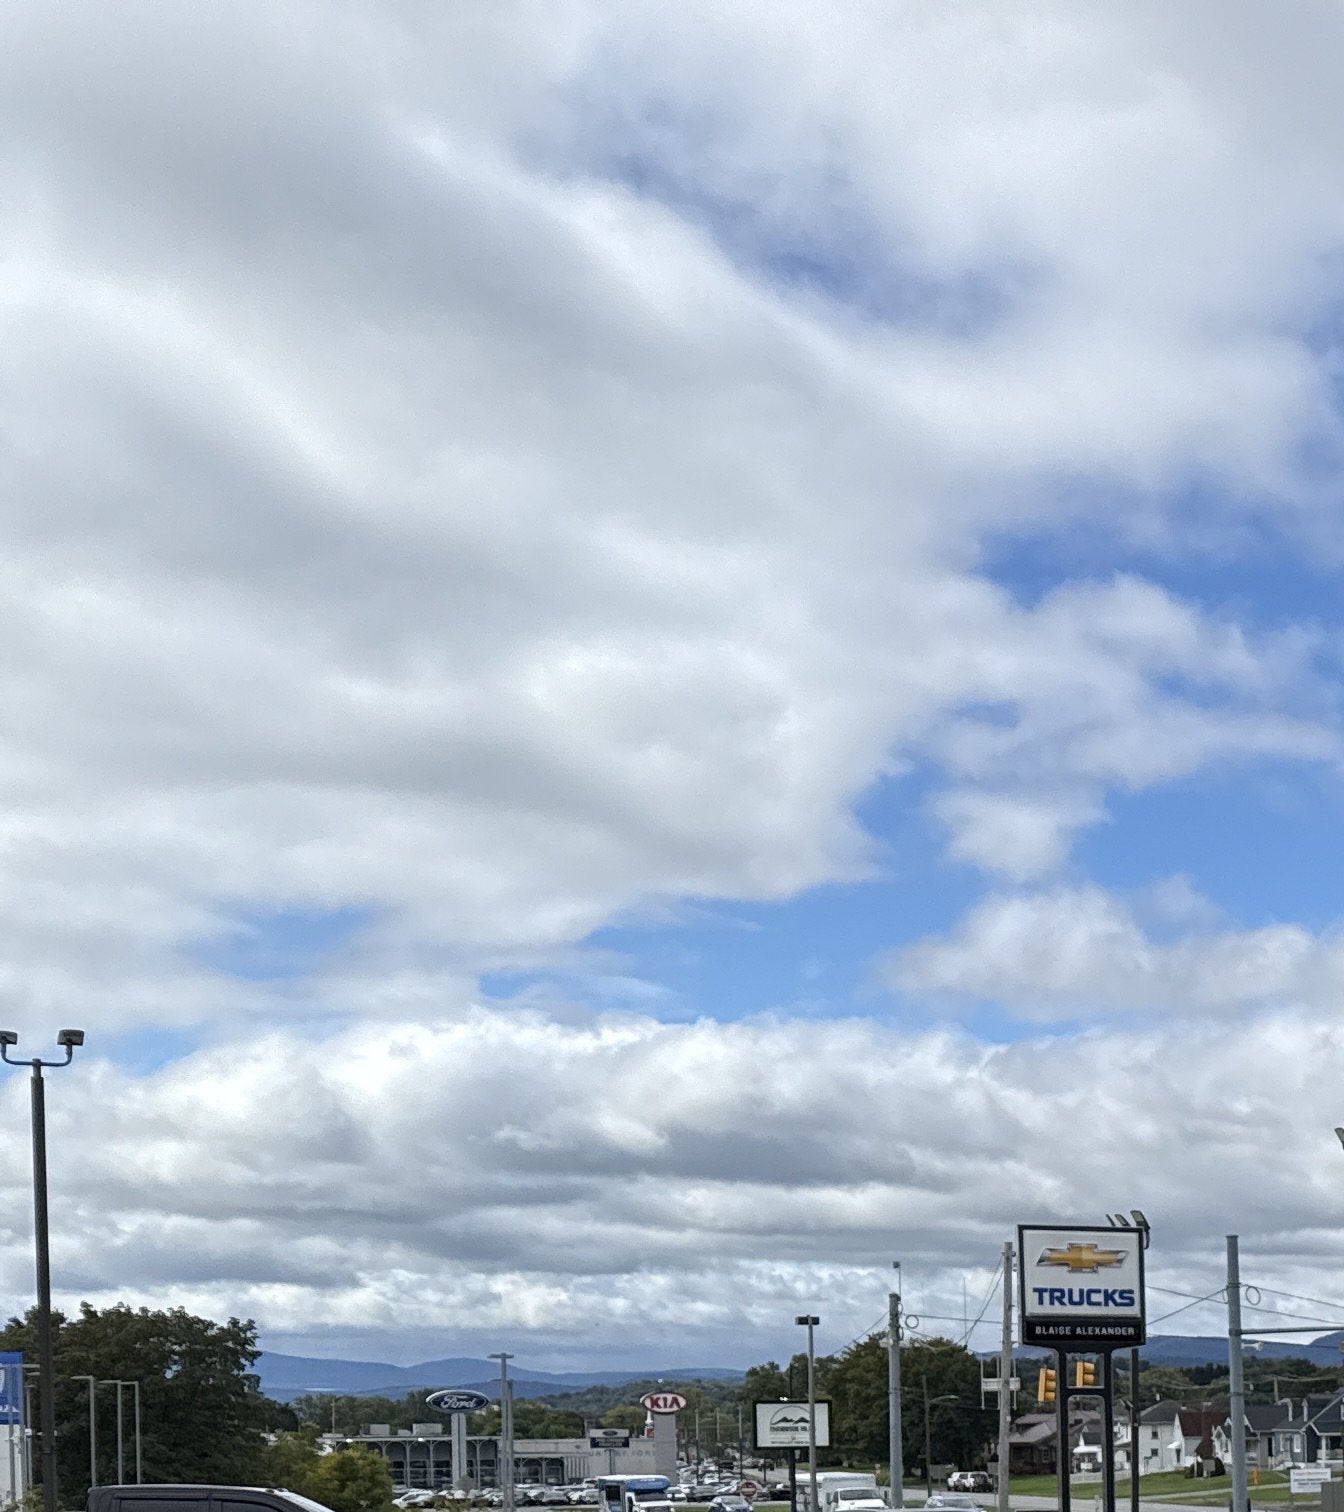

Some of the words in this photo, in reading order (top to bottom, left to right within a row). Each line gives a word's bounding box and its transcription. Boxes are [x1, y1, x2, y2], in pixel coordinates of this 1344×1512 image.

[1032, 1286, 1136, 1307] TRUCKS
[1035, 1325, 1072, 1336] BLAISE
[1075, 1326, 1135, 1336] ALEXANDER
[440, 1394, 477, 1409] Ford
[649, 1396, 681, 1409] KIA
